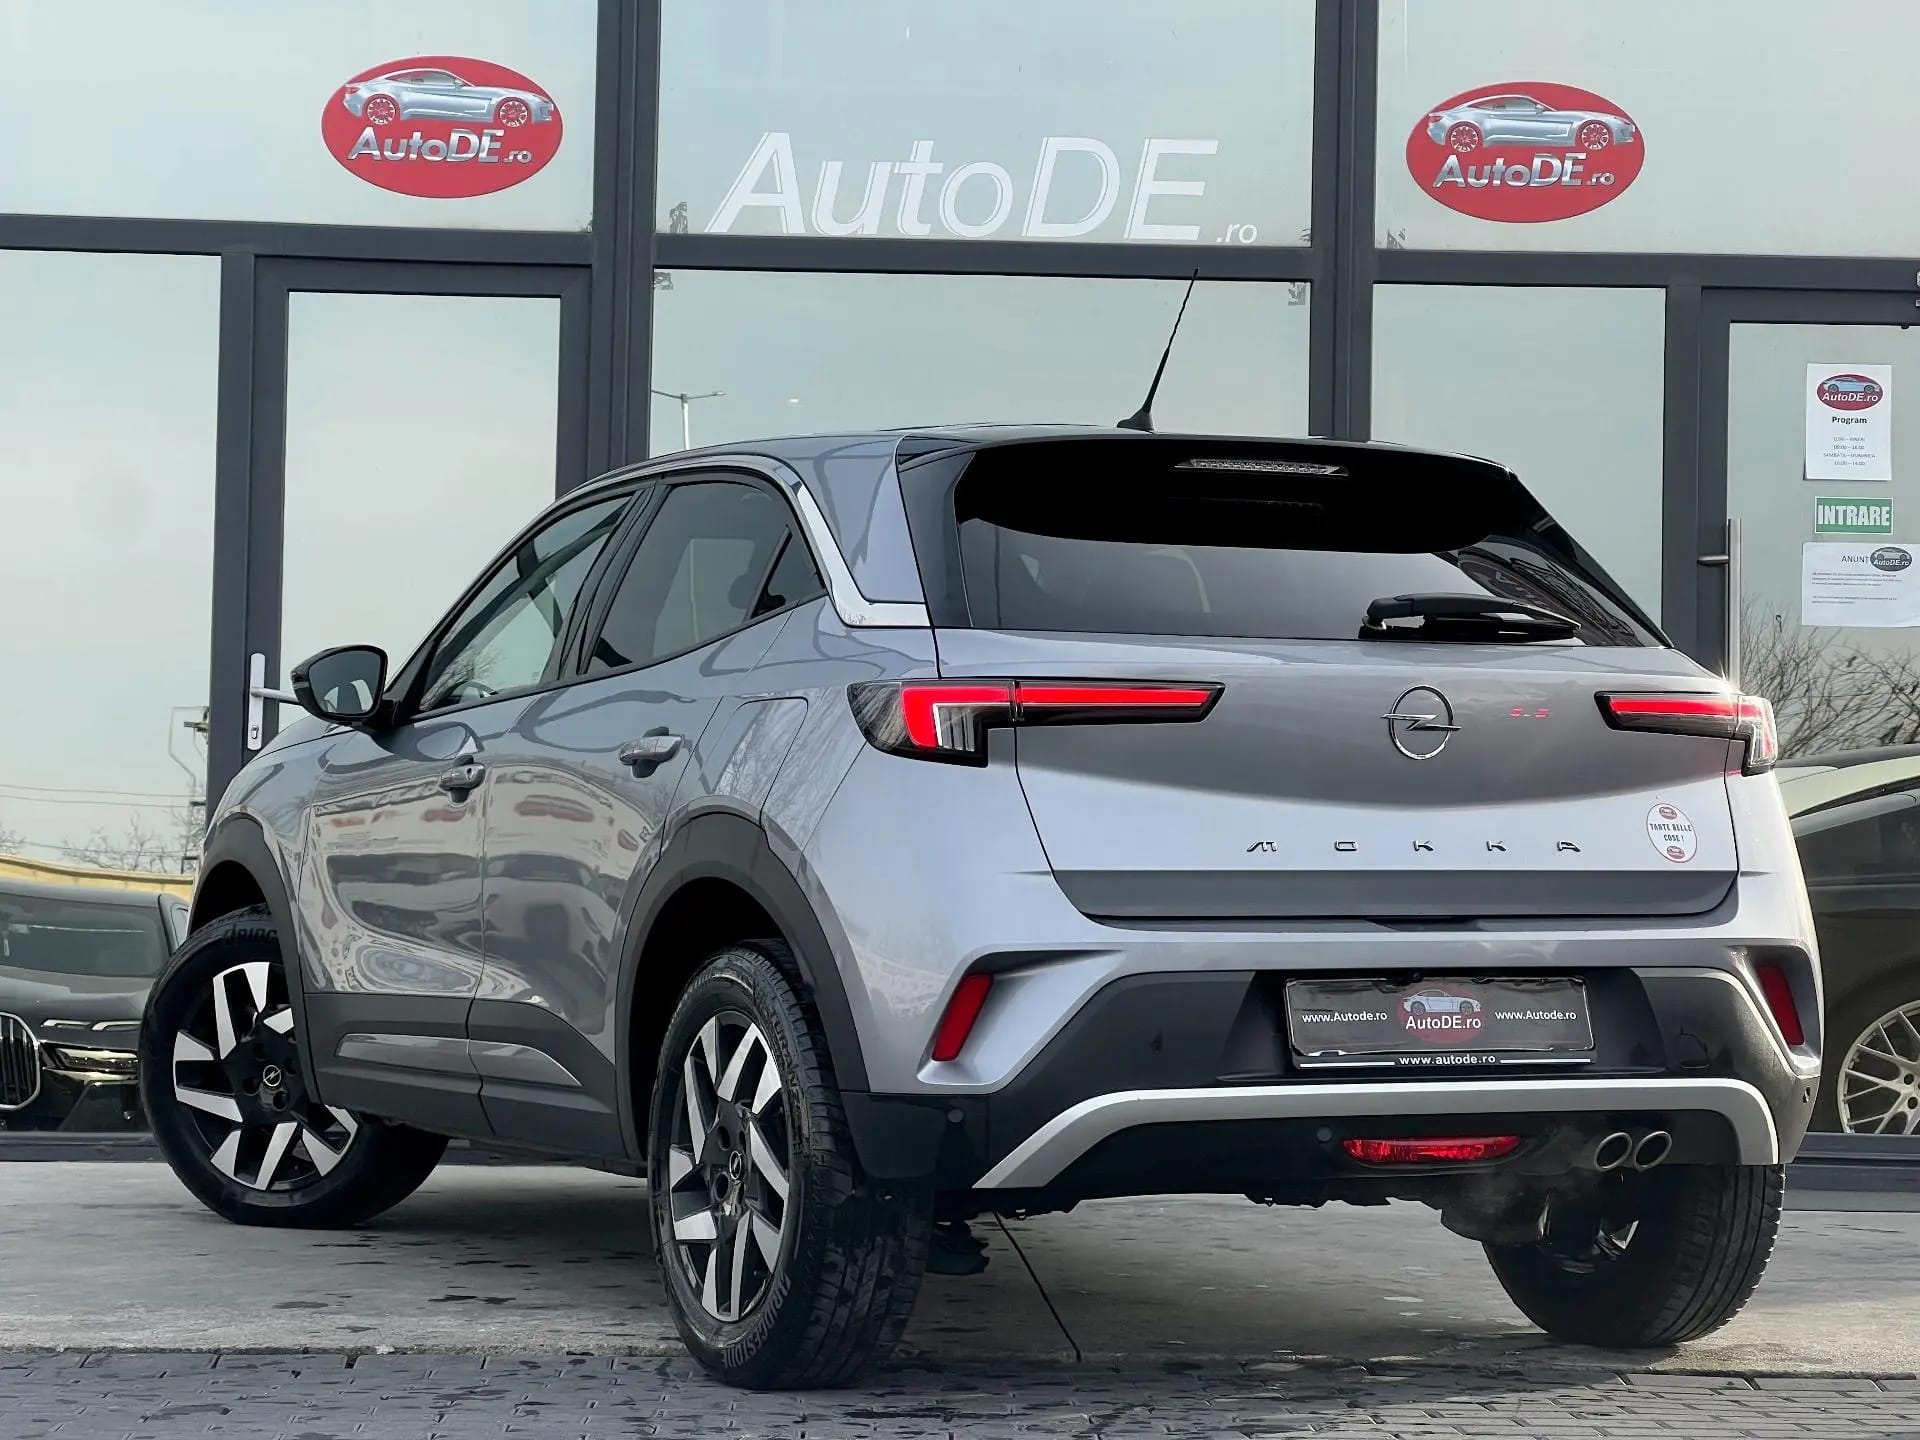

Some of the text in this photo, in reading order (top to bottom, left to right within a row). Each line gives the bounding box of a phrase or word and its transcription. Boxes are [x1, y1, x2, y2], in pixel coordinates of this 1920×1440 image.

[1821, 392, 1879, 402] AutoDE.ro
[1831, 416, 1868, 425] Program
[1817, 505, 1890, 526] INTRARE
[1873, 559, 1910, 567] AutoDE.ro
[1247, 840, 1581, 852] MOKKA
[1302, 1011, 1388, 1023] www.Autode.ro
[1495, 1010, 1577, 1021] www.Autode.ro
[1405, 1015, 1482, 1030] AutoDE.ro
[1399, 1054, 1496, 1066] www.autode.ro
